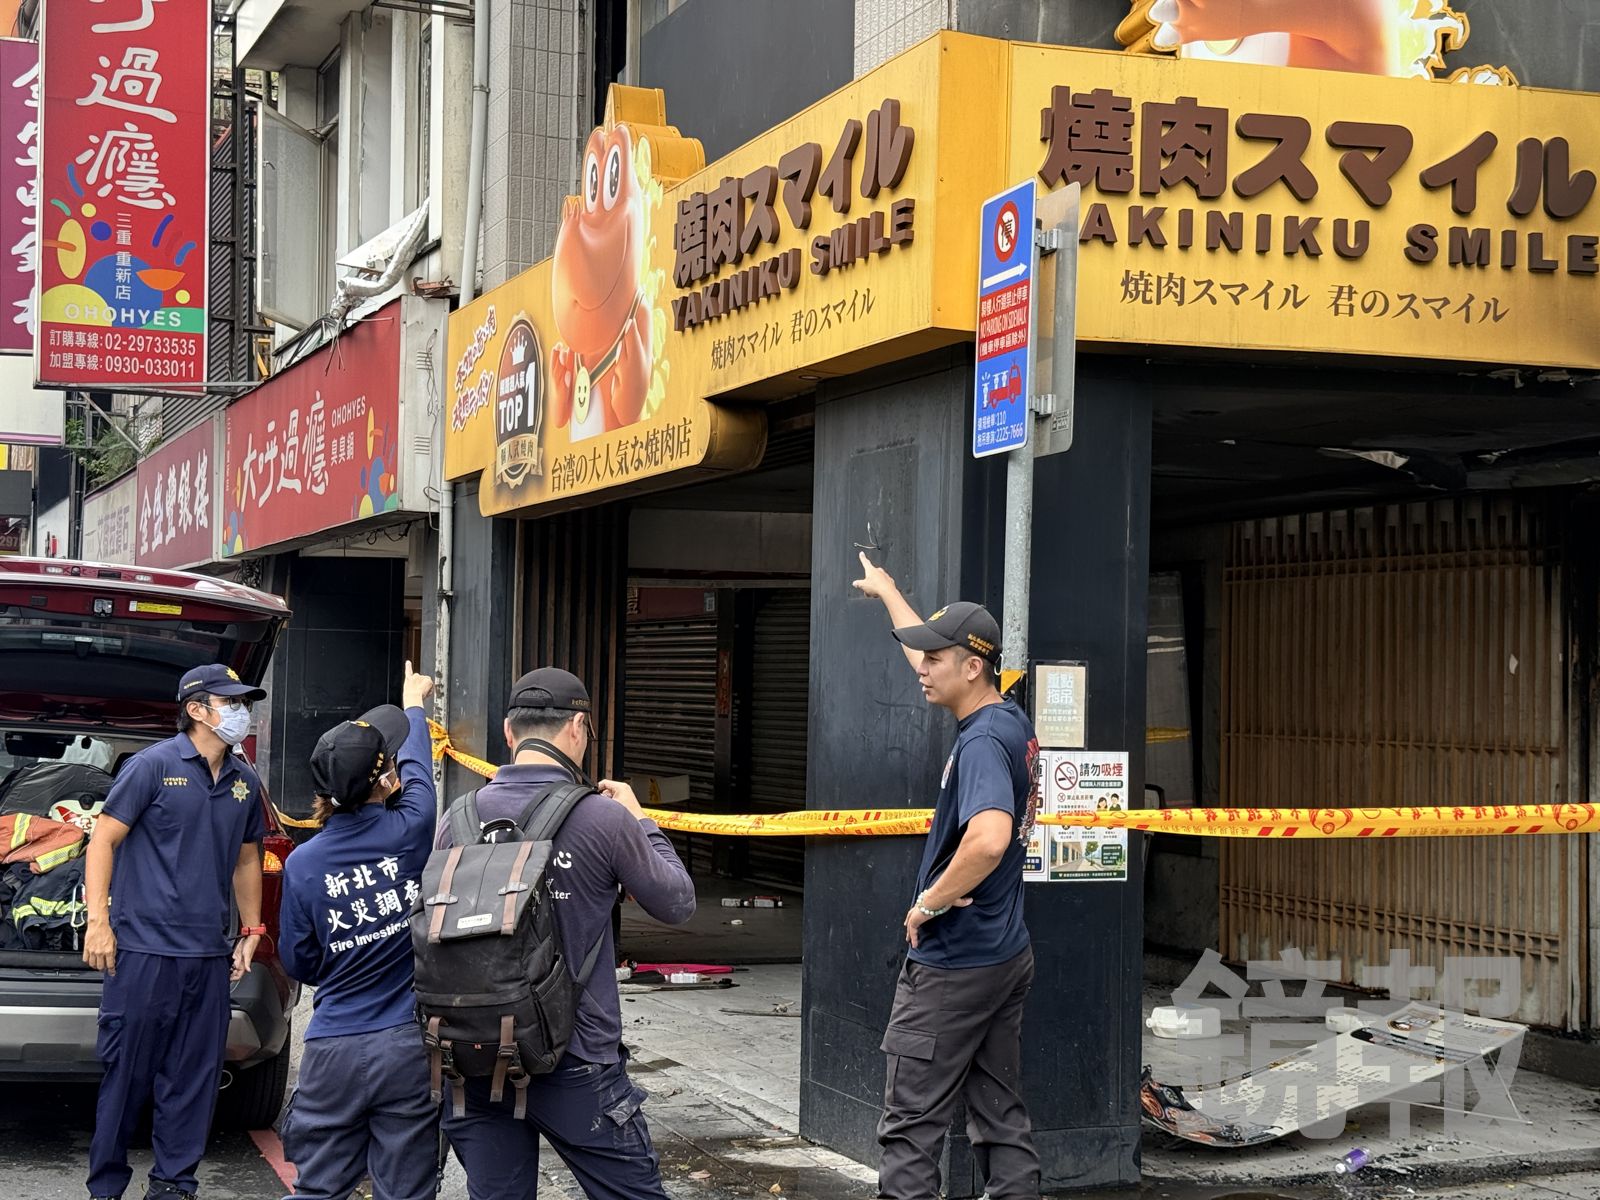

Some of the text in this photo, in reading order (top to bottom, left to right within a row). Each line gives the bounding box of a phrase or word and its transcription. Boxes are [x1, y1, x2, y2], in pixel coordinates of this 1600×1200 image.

[76, 0, 178, 210] 過癮
[1038, 84, 1597, 221] 燒肉スマイル
[673, 98, 915, 288] 燒肉スマイル
[671, 198, 915, 332] YAKINIKU SMILE
[1079, 202, 1600, 275] AKINIKU SMILE
[64, 303, 182, 327] OHOHYES
[791, 287, 876, 344] 君のスマイル
[1119, 269, 1511, 324] 焼肉スマイル 君のスマイル
[331, 395, 366, 429] OHOHYES
[499, 394, 523, 435] TOP
[241, 390, 329, 512] 大呼過癮
[551, 417, 693, 493] 台湾の大人気な焼肉店
[1079, 763, 1123, 777] 請勿吸煙
[324, 856, 399, 898] 新北市
[329, 939, 354, 953] Fire
